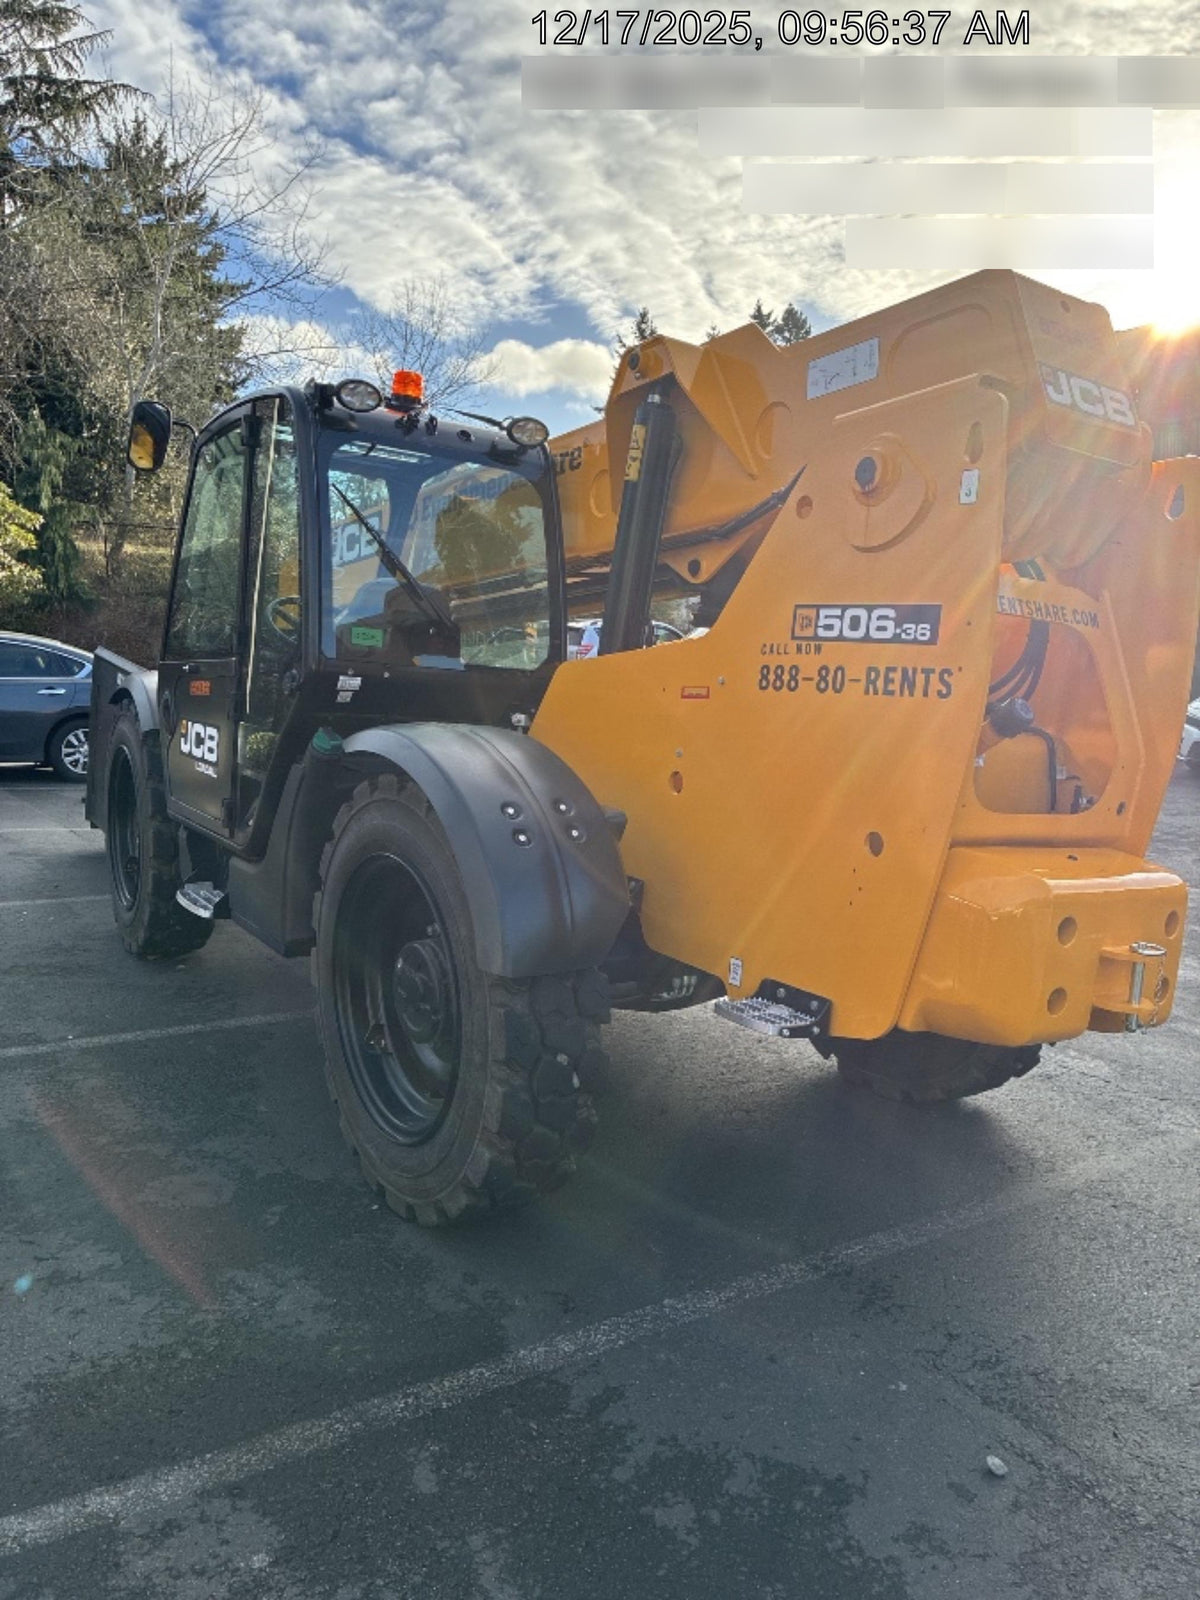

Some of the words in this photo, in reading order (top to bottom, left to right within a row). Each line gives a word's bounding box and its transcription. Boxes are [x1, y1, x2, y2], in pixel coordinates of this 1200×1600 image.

[1046, 370, 1135, 427] JCB
[760, 643, 790, 656] CALL
[796, 643, 822, 655] NOW
[758, 664, 954, 699] 888-80-RENTS
[180, 720, 218, 763] JCB
